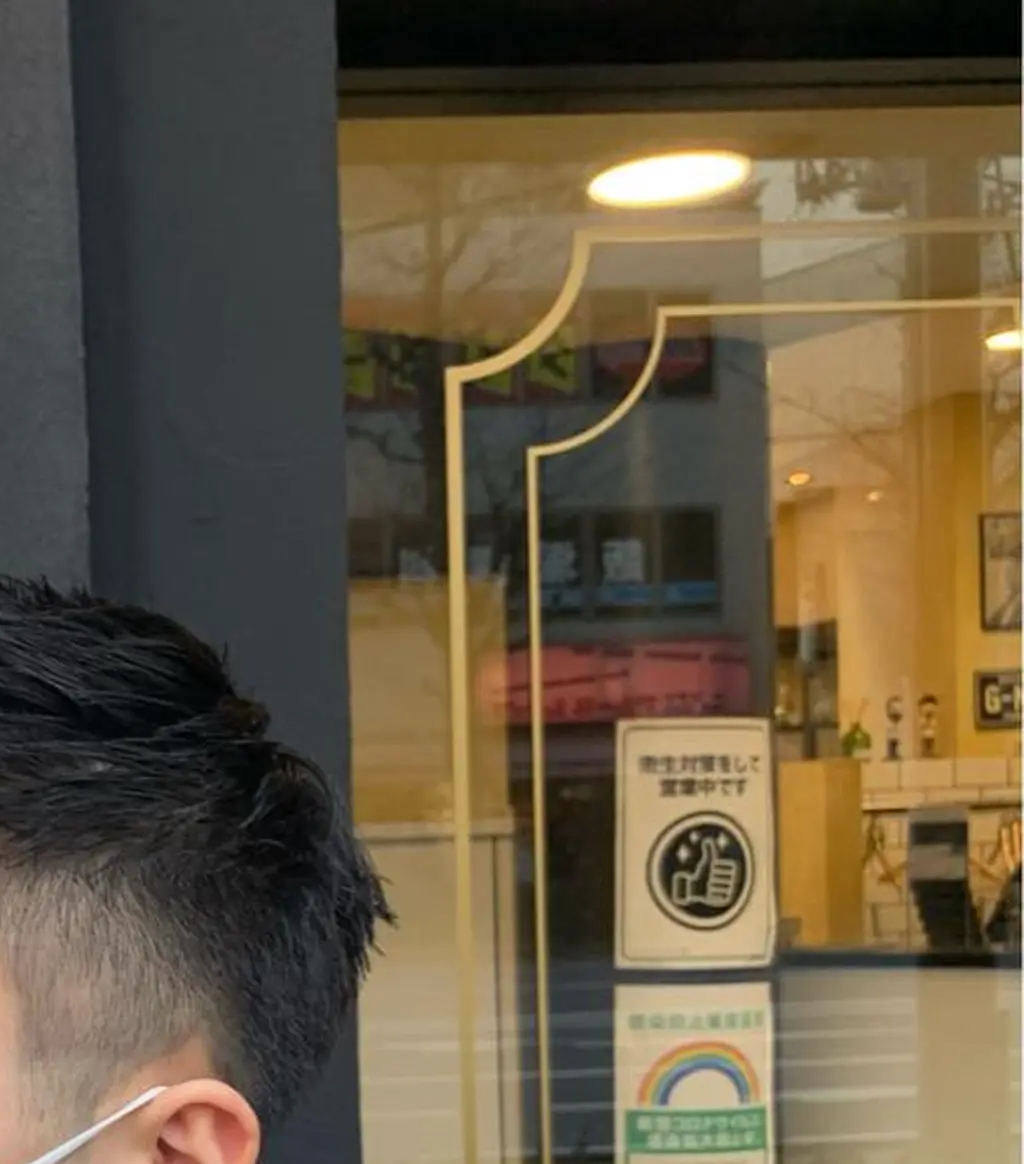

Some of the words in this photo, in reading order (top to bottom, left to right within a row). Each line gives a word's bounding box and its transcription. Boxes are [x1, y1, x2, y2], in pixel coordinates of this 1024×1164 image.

[660, 778, 747, 797] 営業中です
